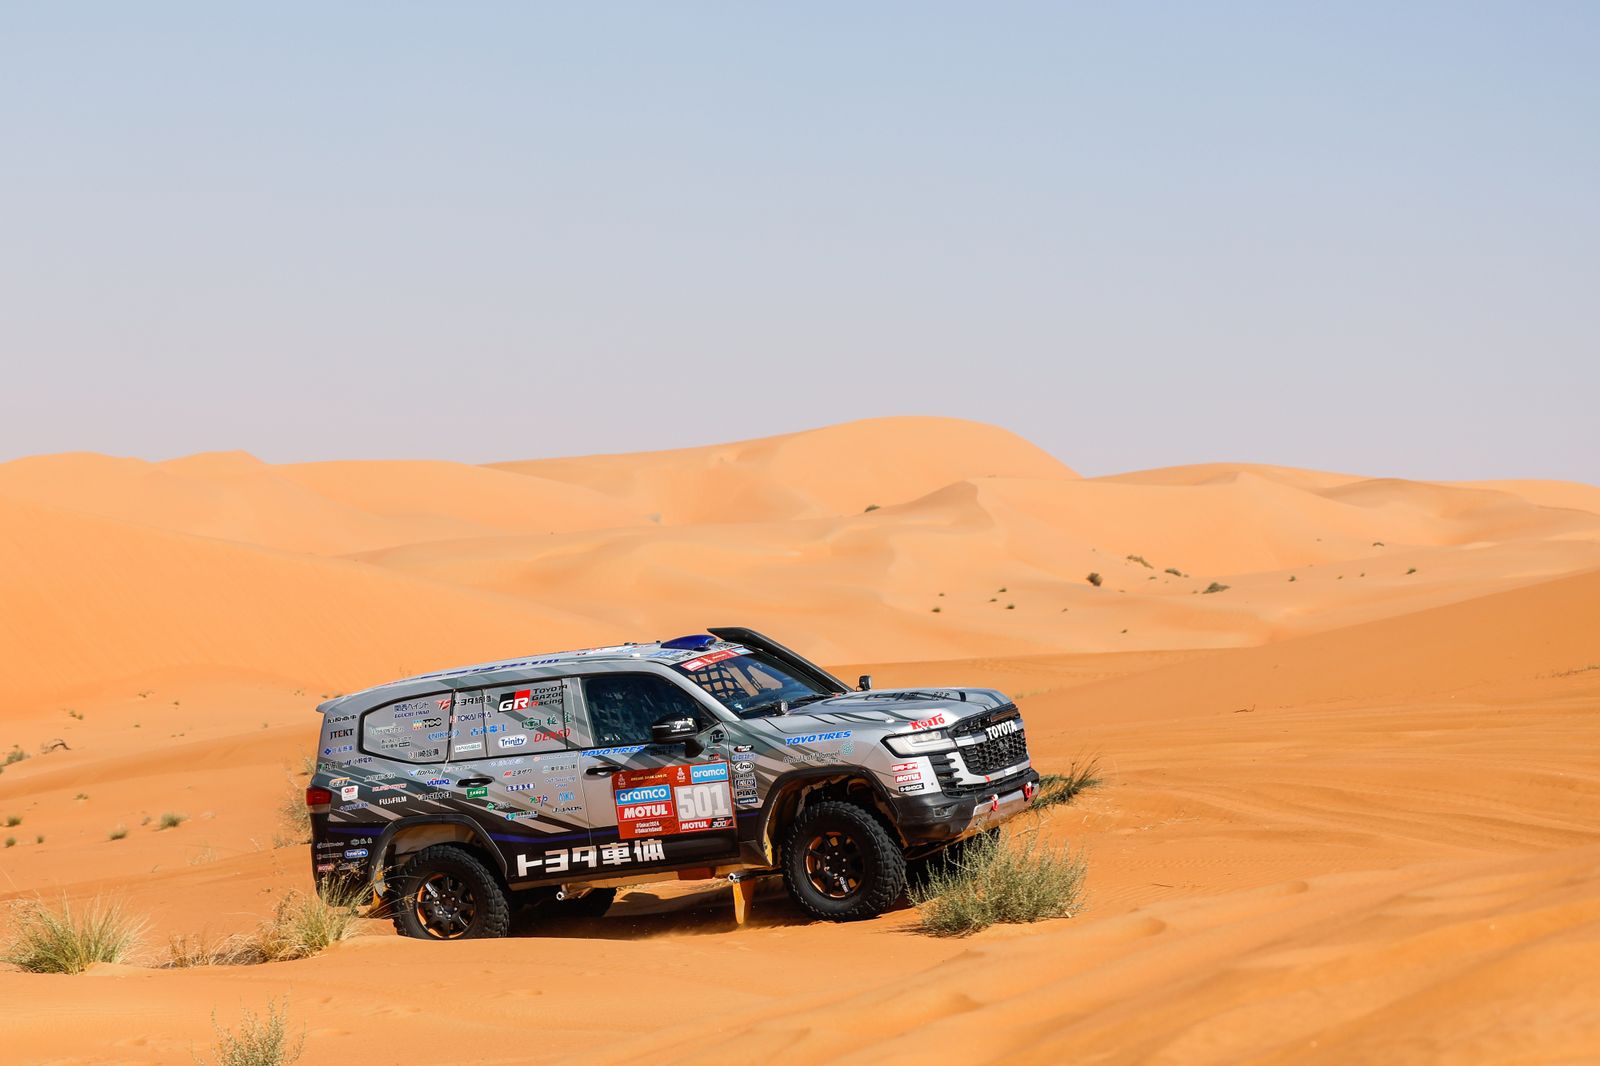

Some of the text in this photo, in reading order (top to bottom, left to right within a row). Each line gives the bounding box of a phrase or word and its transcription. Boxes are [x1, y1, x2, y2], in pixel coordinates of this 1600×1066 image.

[499, 697, 529, 712] GR
[457, 713, 476, 722] TOKAI
[330, 728, 354, 740] JTEKT
[534, 728, 571, 743] DENSO
[986, 720, 1017, 740] TOYOTA
[501, 737, 525, 747] Trinity
[786, 731, 852, 746] TOYO TIRES
[582, 745, 646, 757] TOYO TIRES
[693, 768, 726, 778] aramco
[896, 774, 920, 782] MOTUL
[379, 796, 407, 805] FUJIFILM
[620, 789, 666, 802] aramco
[678, 784, 728, 819] 501
[623, 804, 668, 819] MOTUL
[682, 821, 708, 830] MOTUL
[517, 839, 665, 877] トヨタ車体
